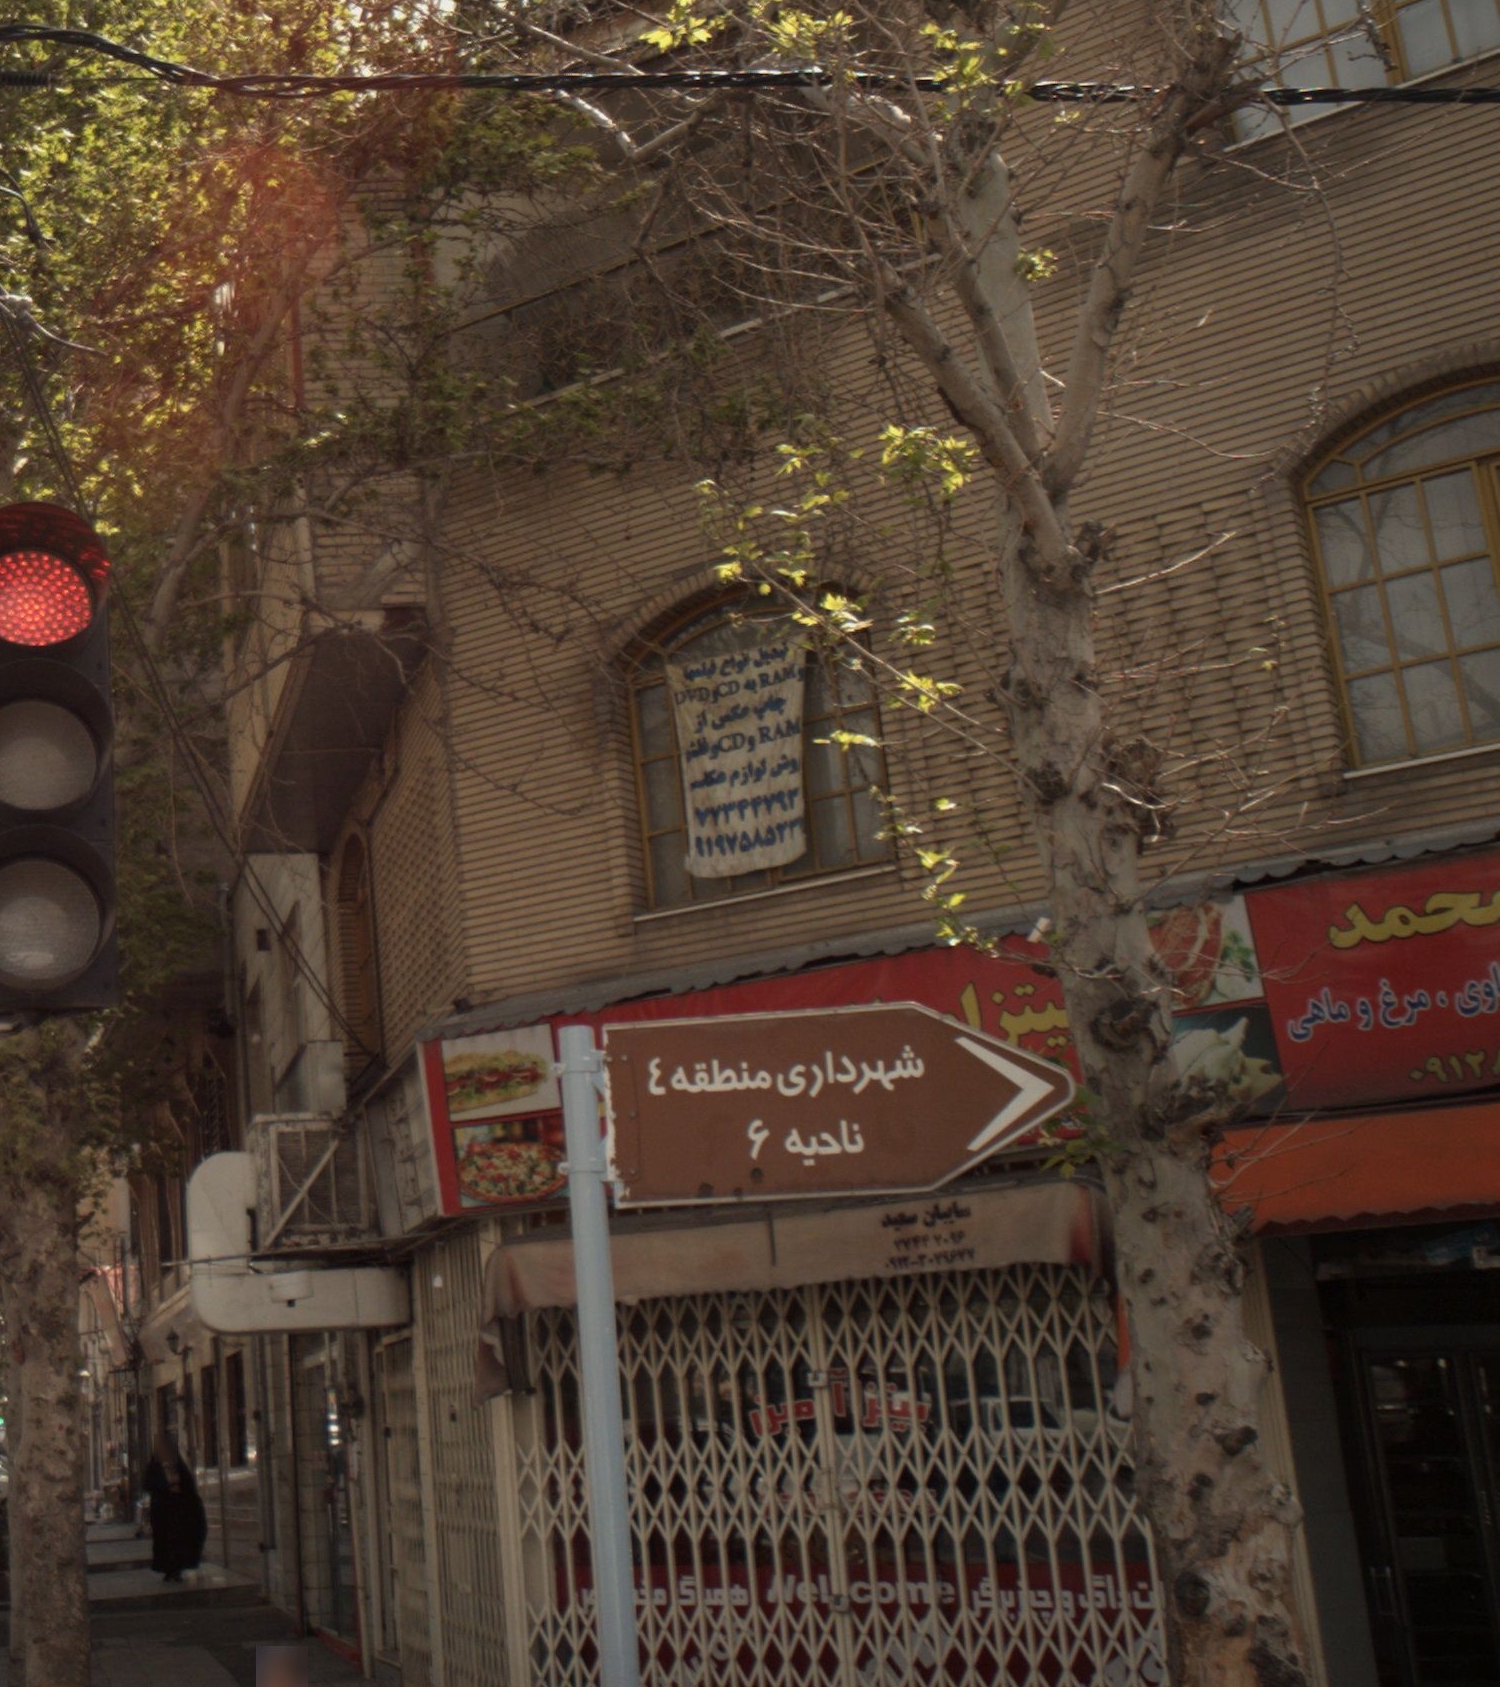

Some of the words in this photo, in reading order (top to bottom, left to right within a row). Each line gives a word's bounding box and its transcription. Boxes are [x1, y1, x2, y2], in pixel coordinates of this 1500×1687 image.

[717, 680, 740, 697] CD
[758, 665, 796, 688] RAM
[674, 687, 710, 705] DVD
[718, 732, 745, 752] CD
[758, 717, 801, 744] RAM
[1328, 891, 1500, 949] حمد
[960, 981, 1070, 1050] یتزا
[1288, 988, 1350, 1043] ماهی
[1357, 998, 1373, 1031] و
[1380, 977, 1431, 1029] مرغ
[670, 1057, 772, 1094] منطقه
[776, 1045, 926, 1098] شهرداری
[784, 1119, 866, 1166] ناحیه
